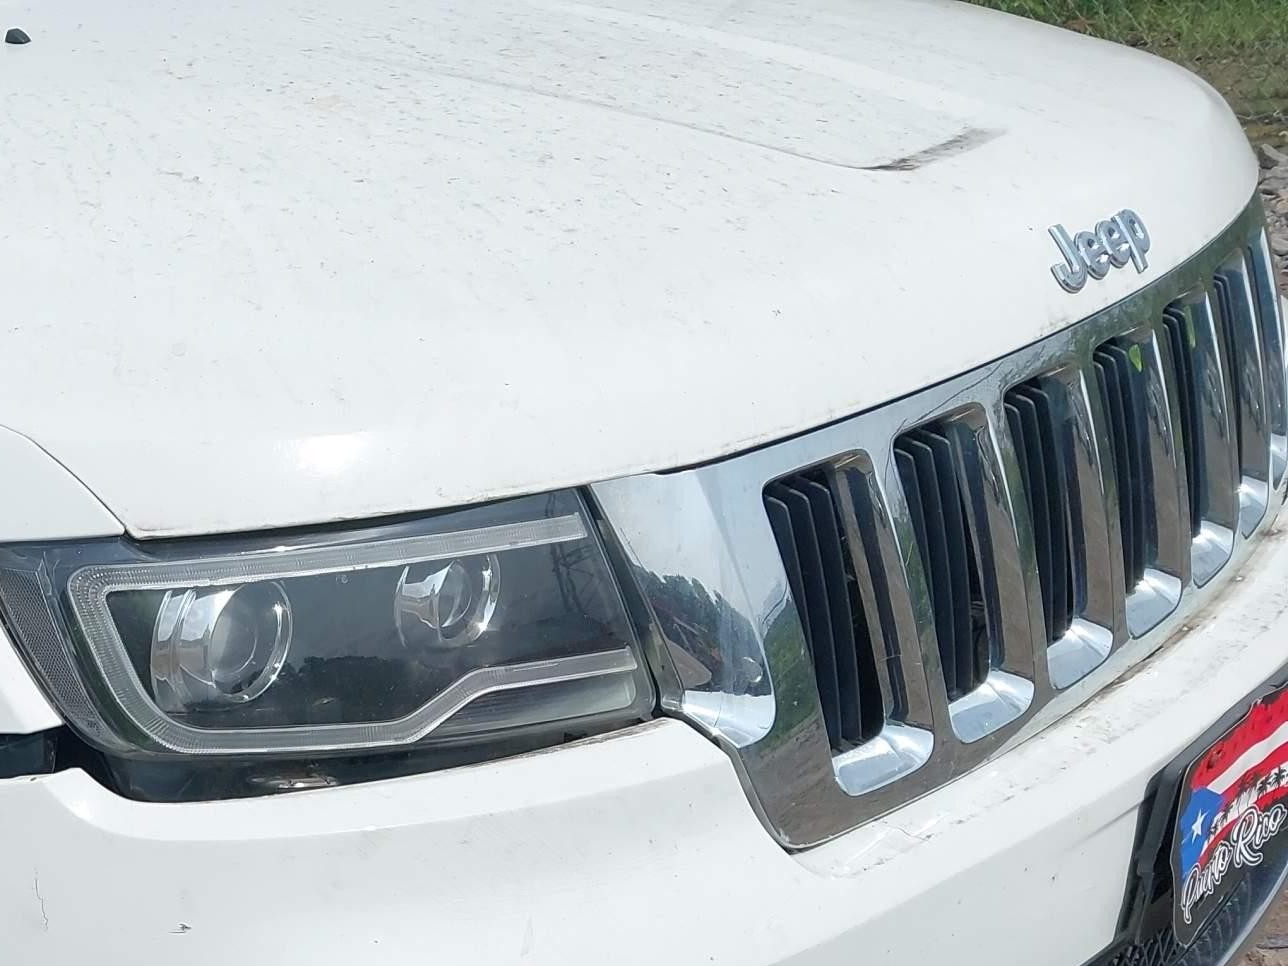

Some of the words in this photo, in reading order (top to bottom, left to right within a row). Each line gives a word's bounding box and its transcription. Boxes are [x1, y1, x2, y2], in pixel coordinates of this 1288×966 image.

[1048, 208, 1151, 294] Jeep
[1181, 840, 1233, 924] Puerto
[1231, 804, 1288, 868] Rico
